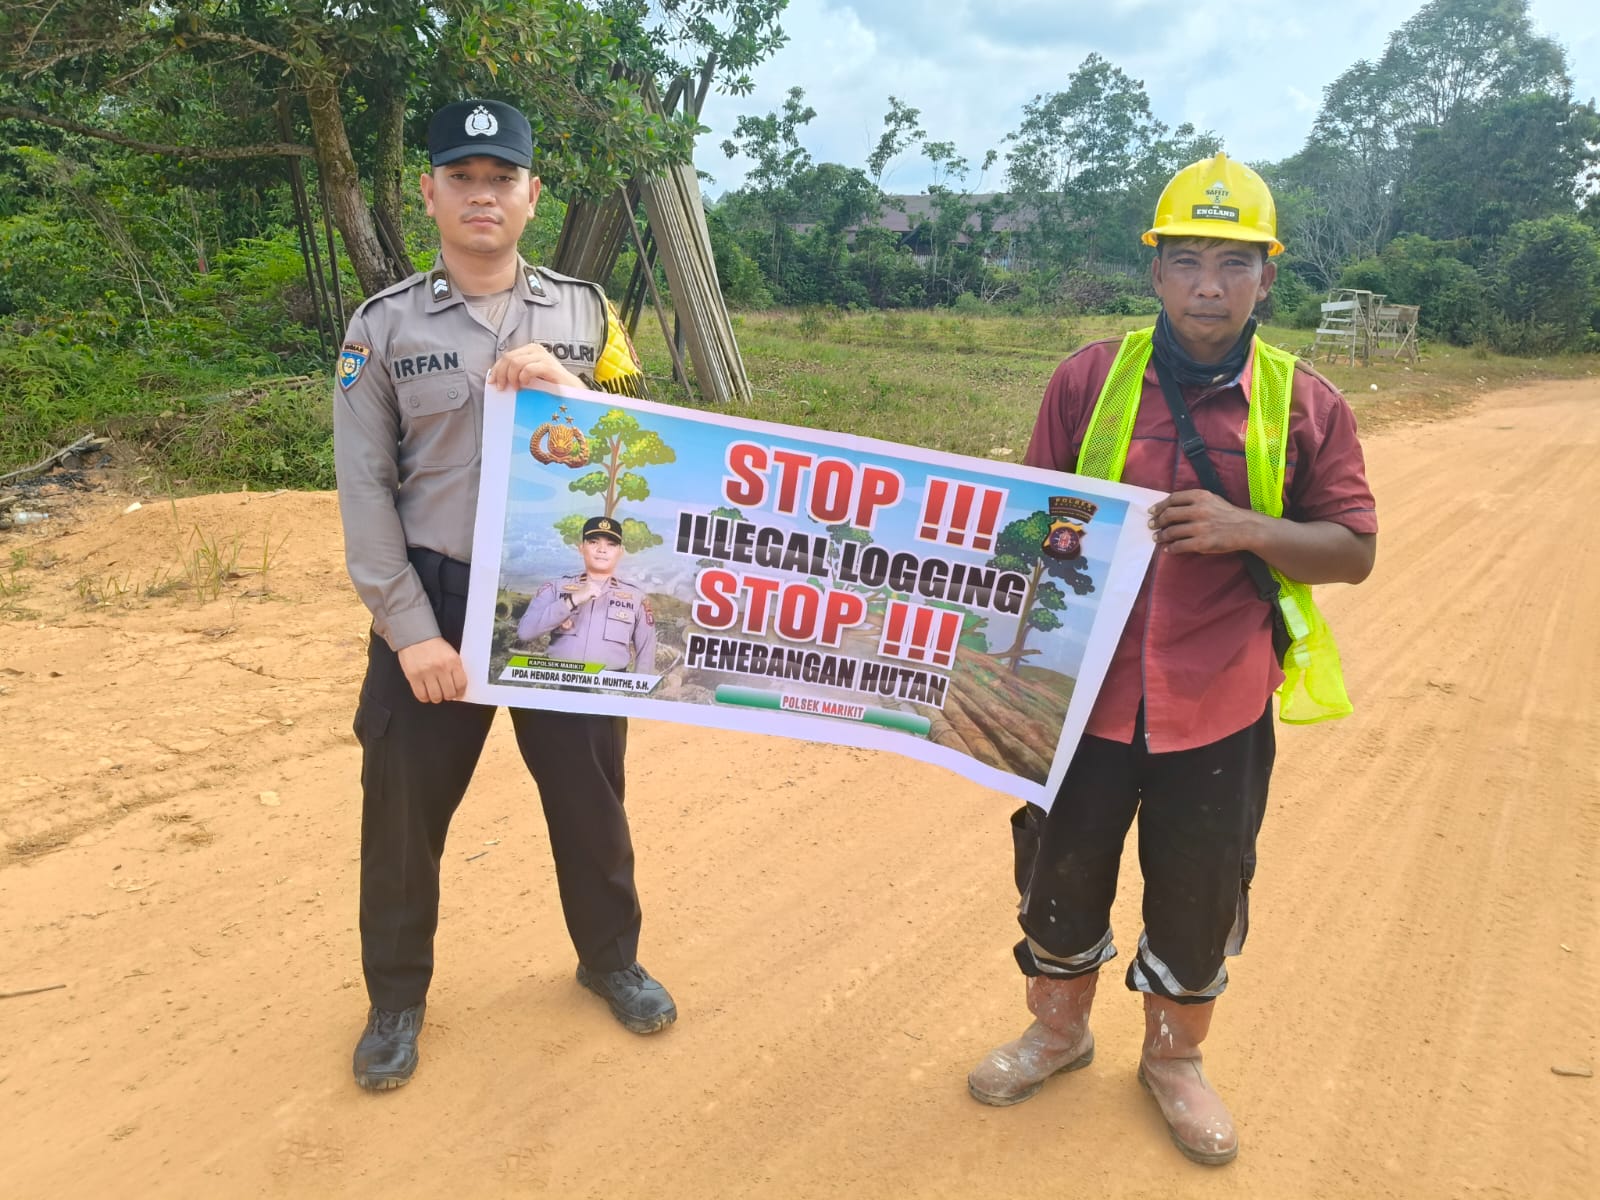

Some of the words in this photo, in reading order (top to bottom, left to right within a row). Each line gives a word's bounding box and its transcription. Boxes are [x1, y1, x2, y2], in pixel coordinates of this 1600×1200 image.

[1196, 208, 1236, 217] ENGLAND
[393, 351, 459, 379] IRFAN
[725, 443, 901, 529] STOP
[919, 479, 1003, 552] !!!
[676, 512, 830, 577] ILLEGAL
[839, 541, 1027, 616] LOGGING
[609, 599, 634, 610] POLRI
[696, 570, 863, 645] STOP
[882, 602, 960, 666] !!!
[528, 659, 560, 669] KAPOLSEK
[687, 635, 857, 689] PENEBANGAN
[859, 662, 948, 708] HUTAN
[511, 668, 529, 679] IPDA
[530, 670, 560, 682] HENDRA
[561, 673, 593, 685] SOPIYAN
[594, 676, 601, 686] D.
[602, 677, 635, 690] MUNTHE,
[635, 680, 650, 691] S.H.
[782, 695, 820, 713] POLSEK
[821, 703, 864, 719] MARIKIT
